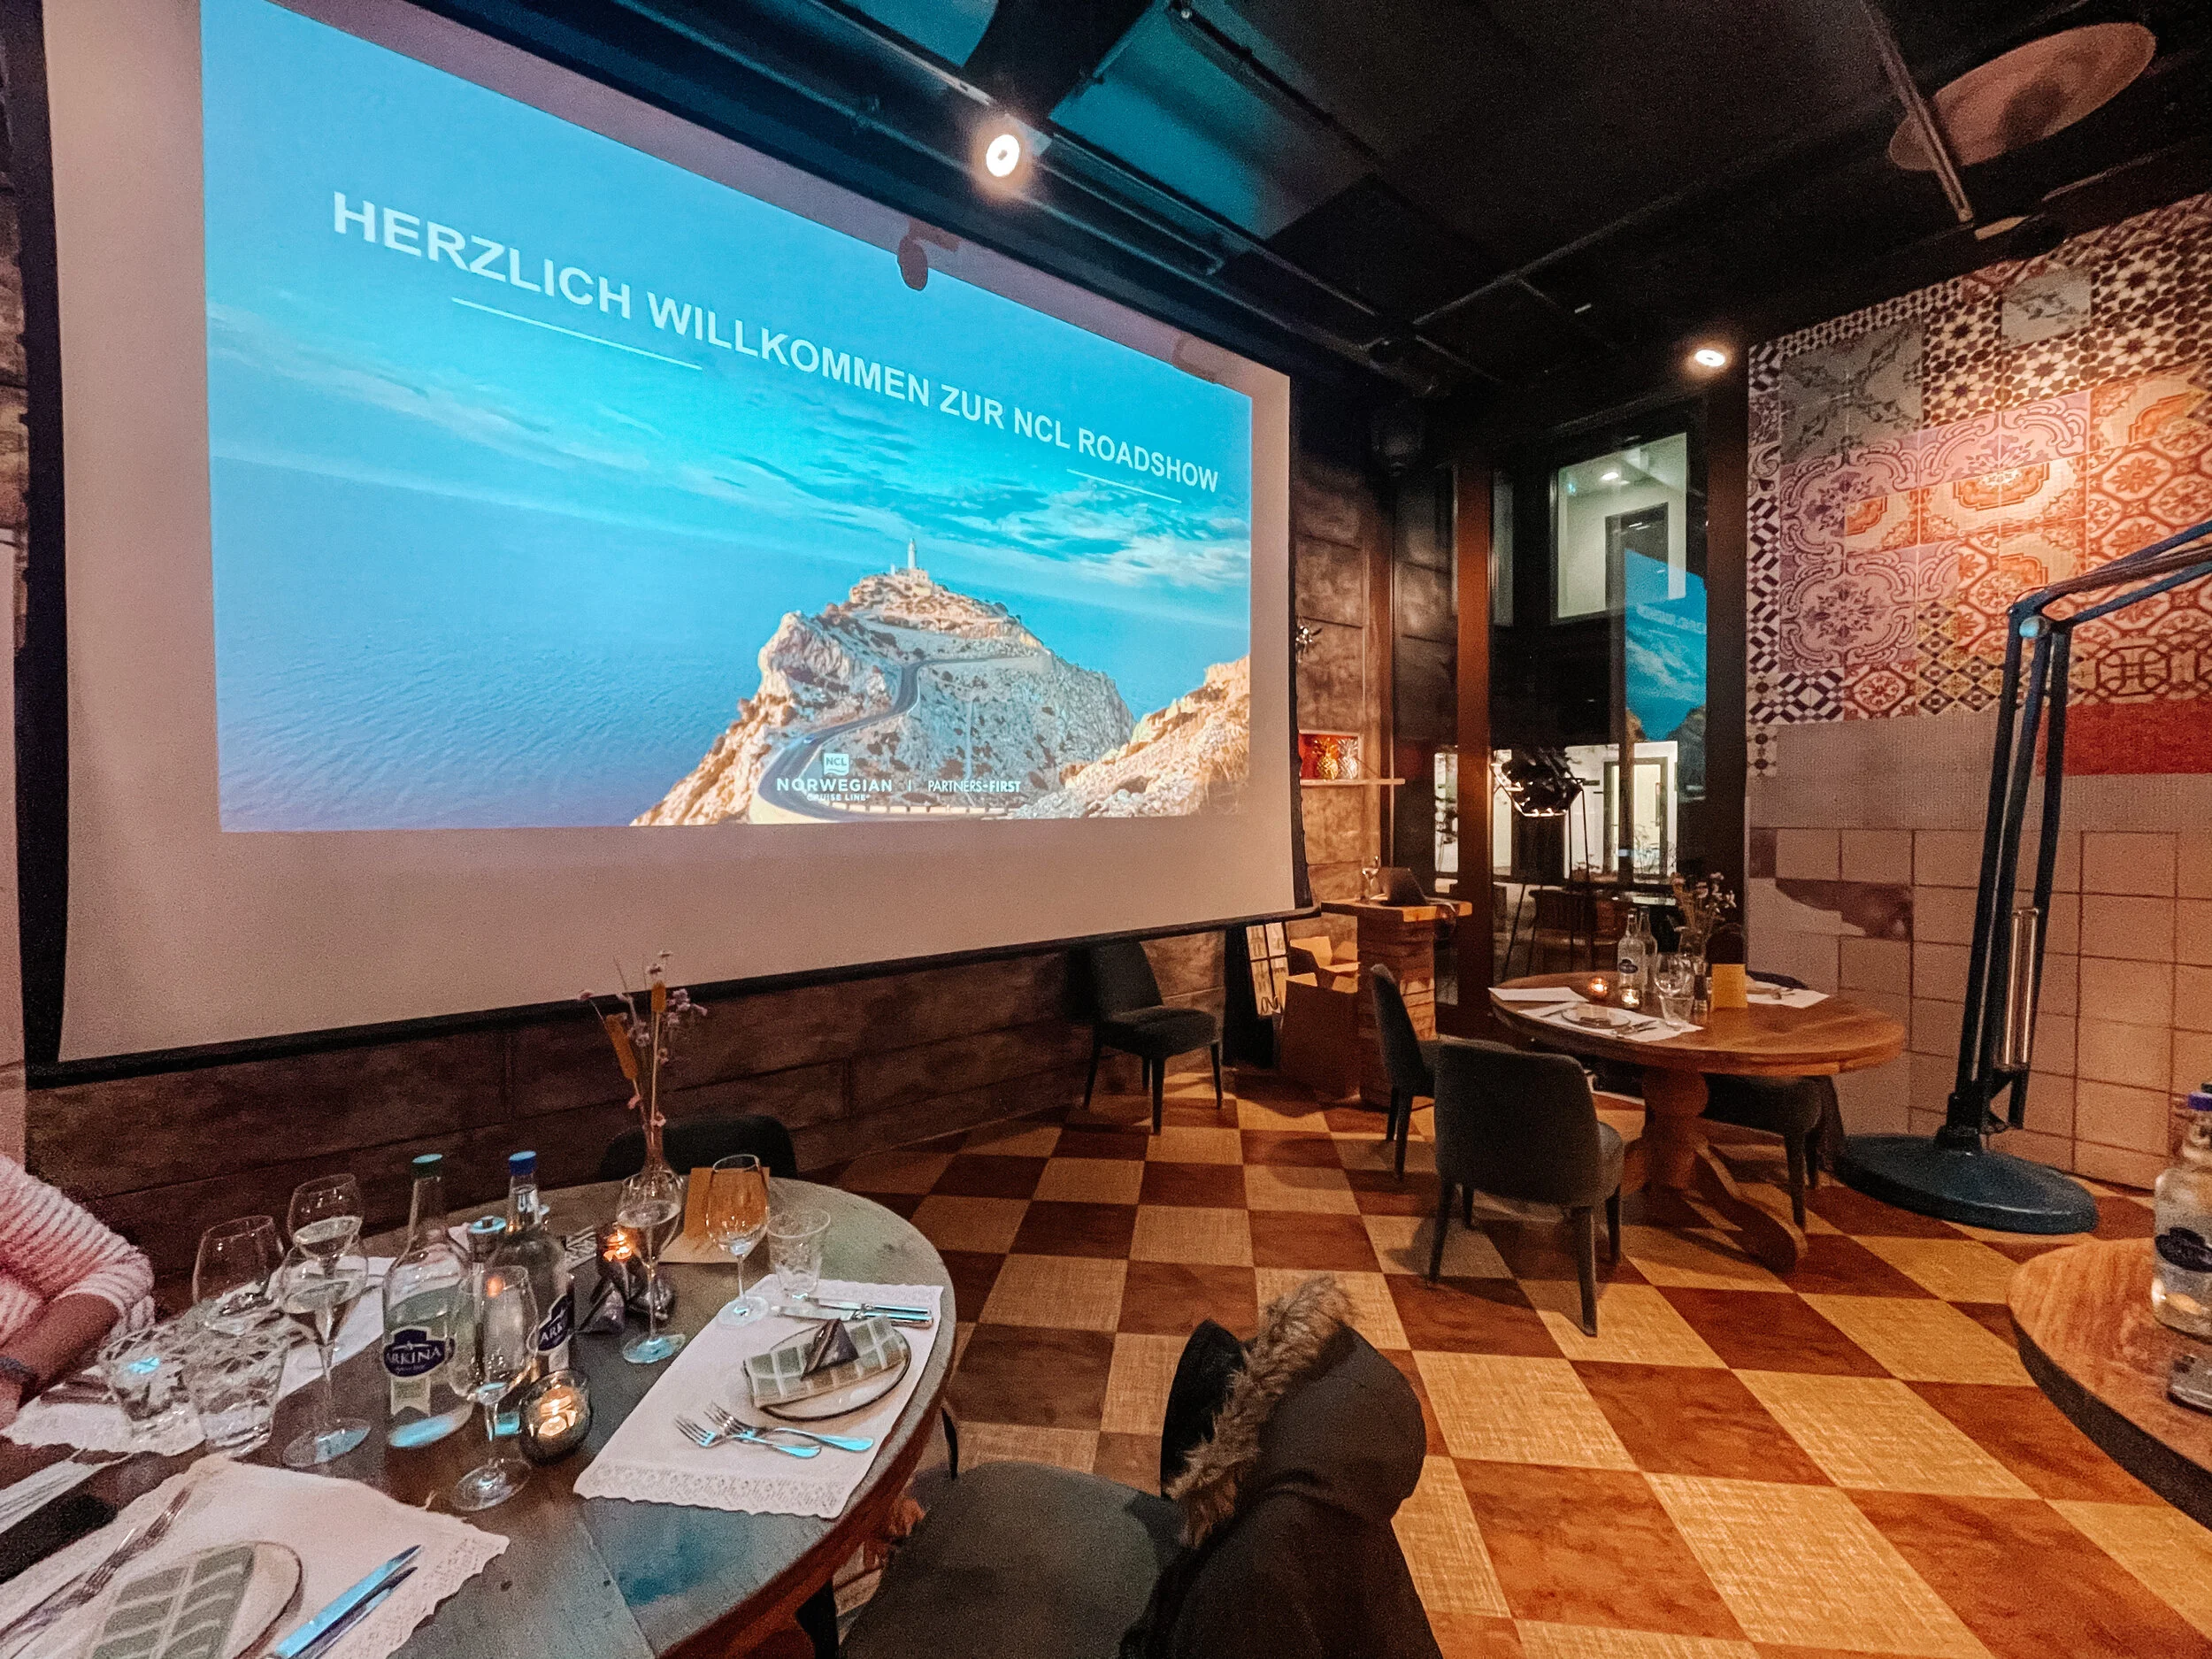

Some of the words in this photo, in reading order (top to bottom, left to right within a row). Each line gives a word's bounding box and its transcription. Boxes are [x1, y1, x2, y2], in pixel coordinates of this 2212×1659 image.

[334, 191, 631, 319] HERZLICH
[647, 291, 930, 407] WILLKOMMEN
[940, 383, 1005, 431] ZUR
[1014, 406, 1071, 449] NCL
[1078, 426, 1219, 494] ROADSHOW
[826, 757, 847, 766] NCL
[776, 778, 893, 793] NORWEGIAN
[806, 793, 842, 802] CRUISE
